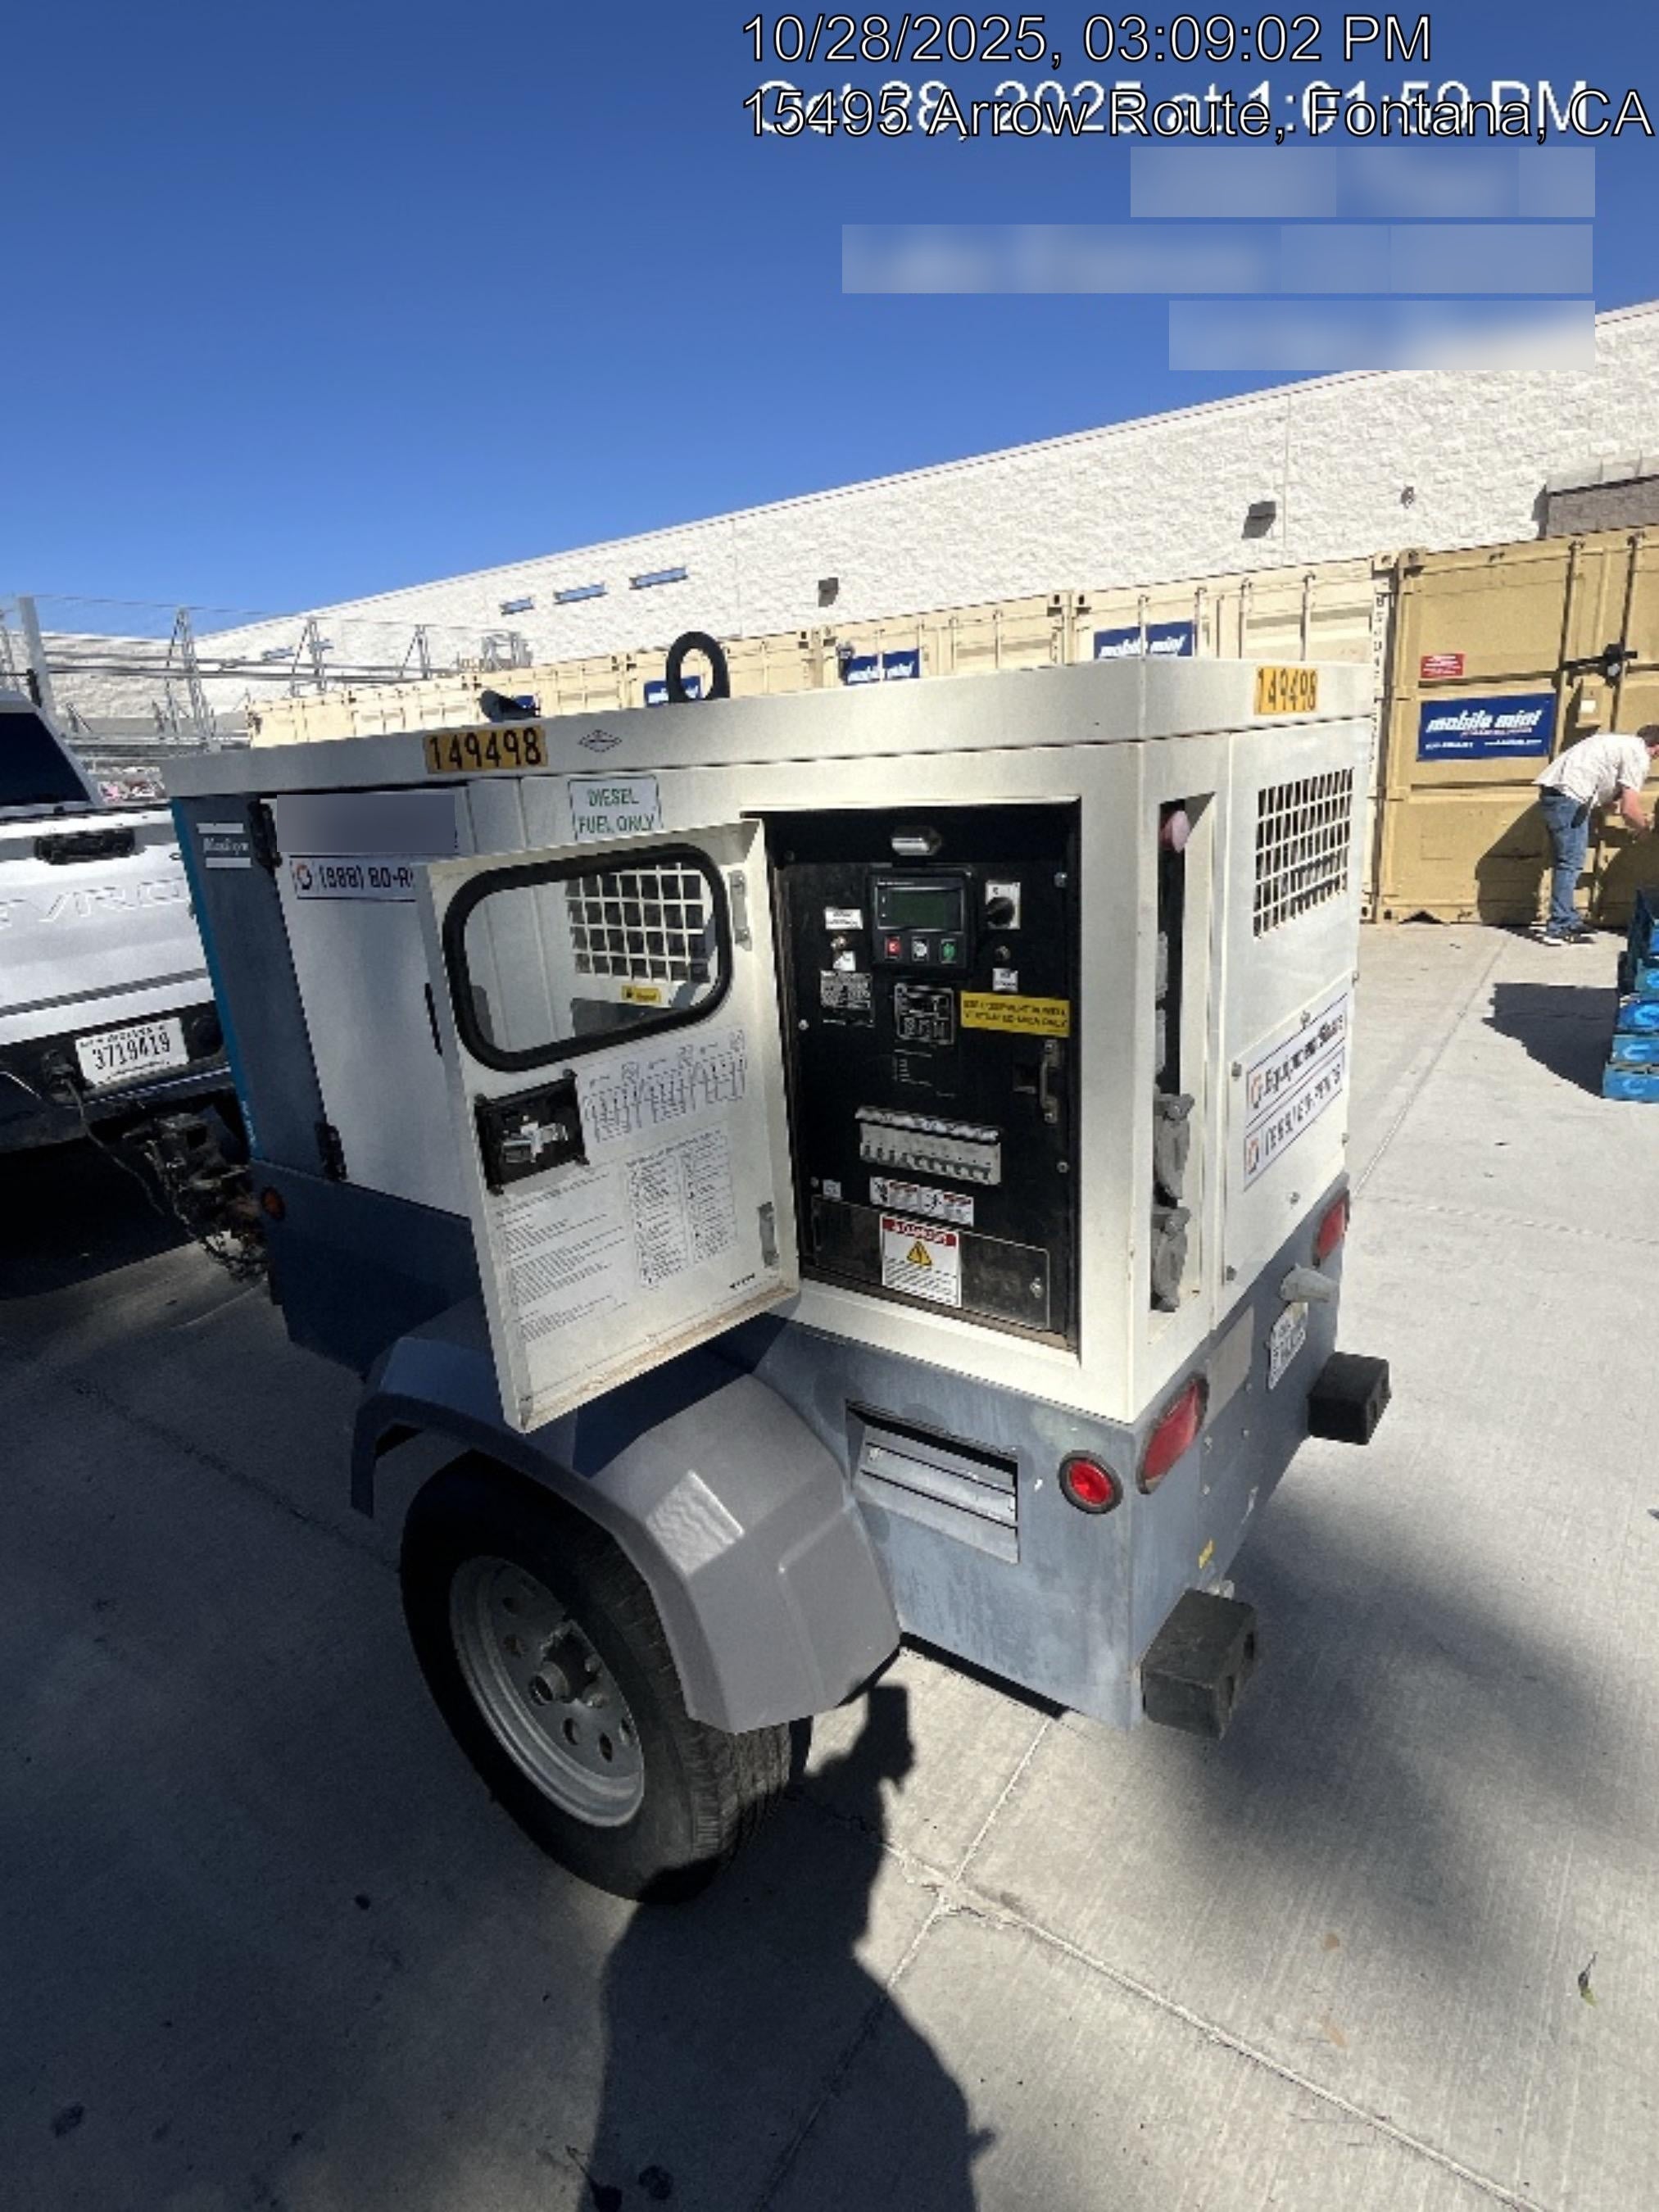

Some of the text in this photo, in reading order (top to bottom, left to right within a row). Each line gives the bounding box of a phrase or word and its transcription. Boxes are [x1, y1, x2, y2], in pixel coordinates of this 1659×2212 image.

[1258, 667, 1317, 713] 149498
[428, 727, 542, 770] 149498
[587, 787, 640, 807] DIESEL
[578, 813, 654, 834] FUEL ONLY
